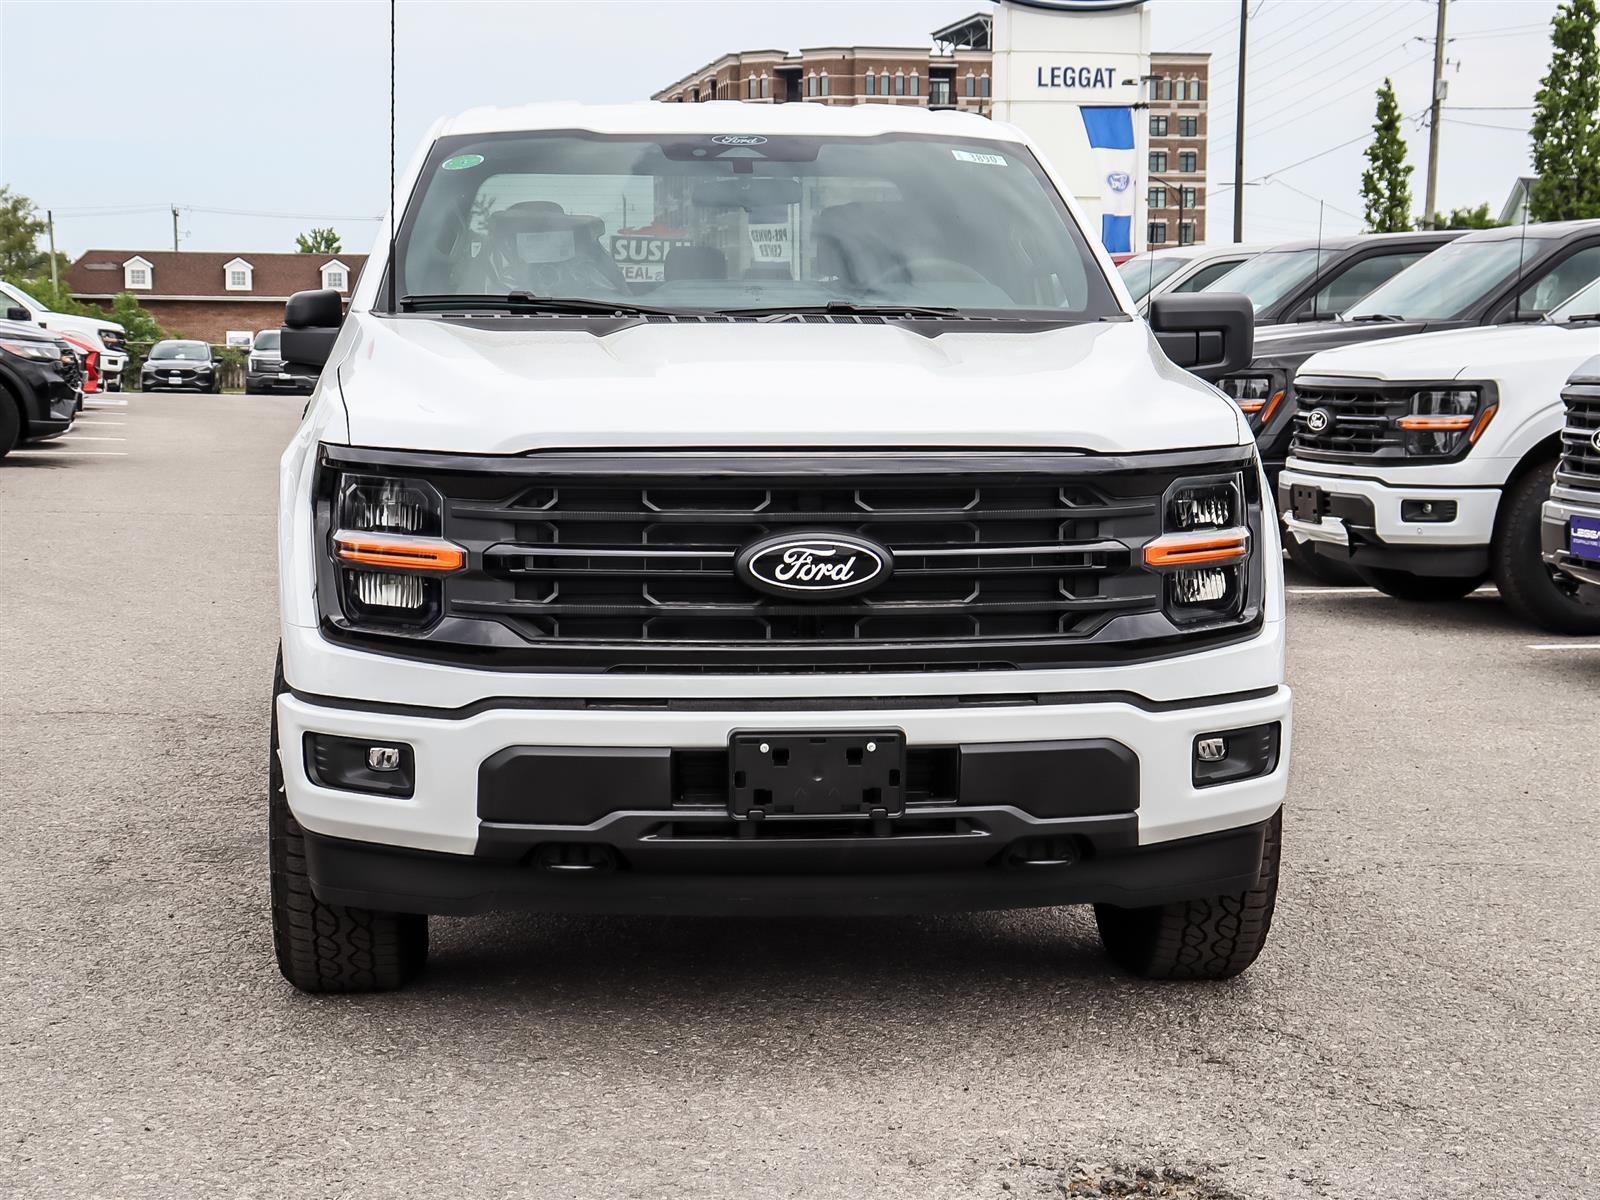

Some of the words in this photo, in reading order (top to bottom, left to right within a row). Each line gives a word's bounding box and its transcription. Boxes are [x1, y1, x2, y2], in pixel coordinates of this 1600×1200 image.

[1038, 66, 1116, 88] LEGGAT
[721, 134, 758, 144] Ford
[774, 547, 856, 581] Ford
